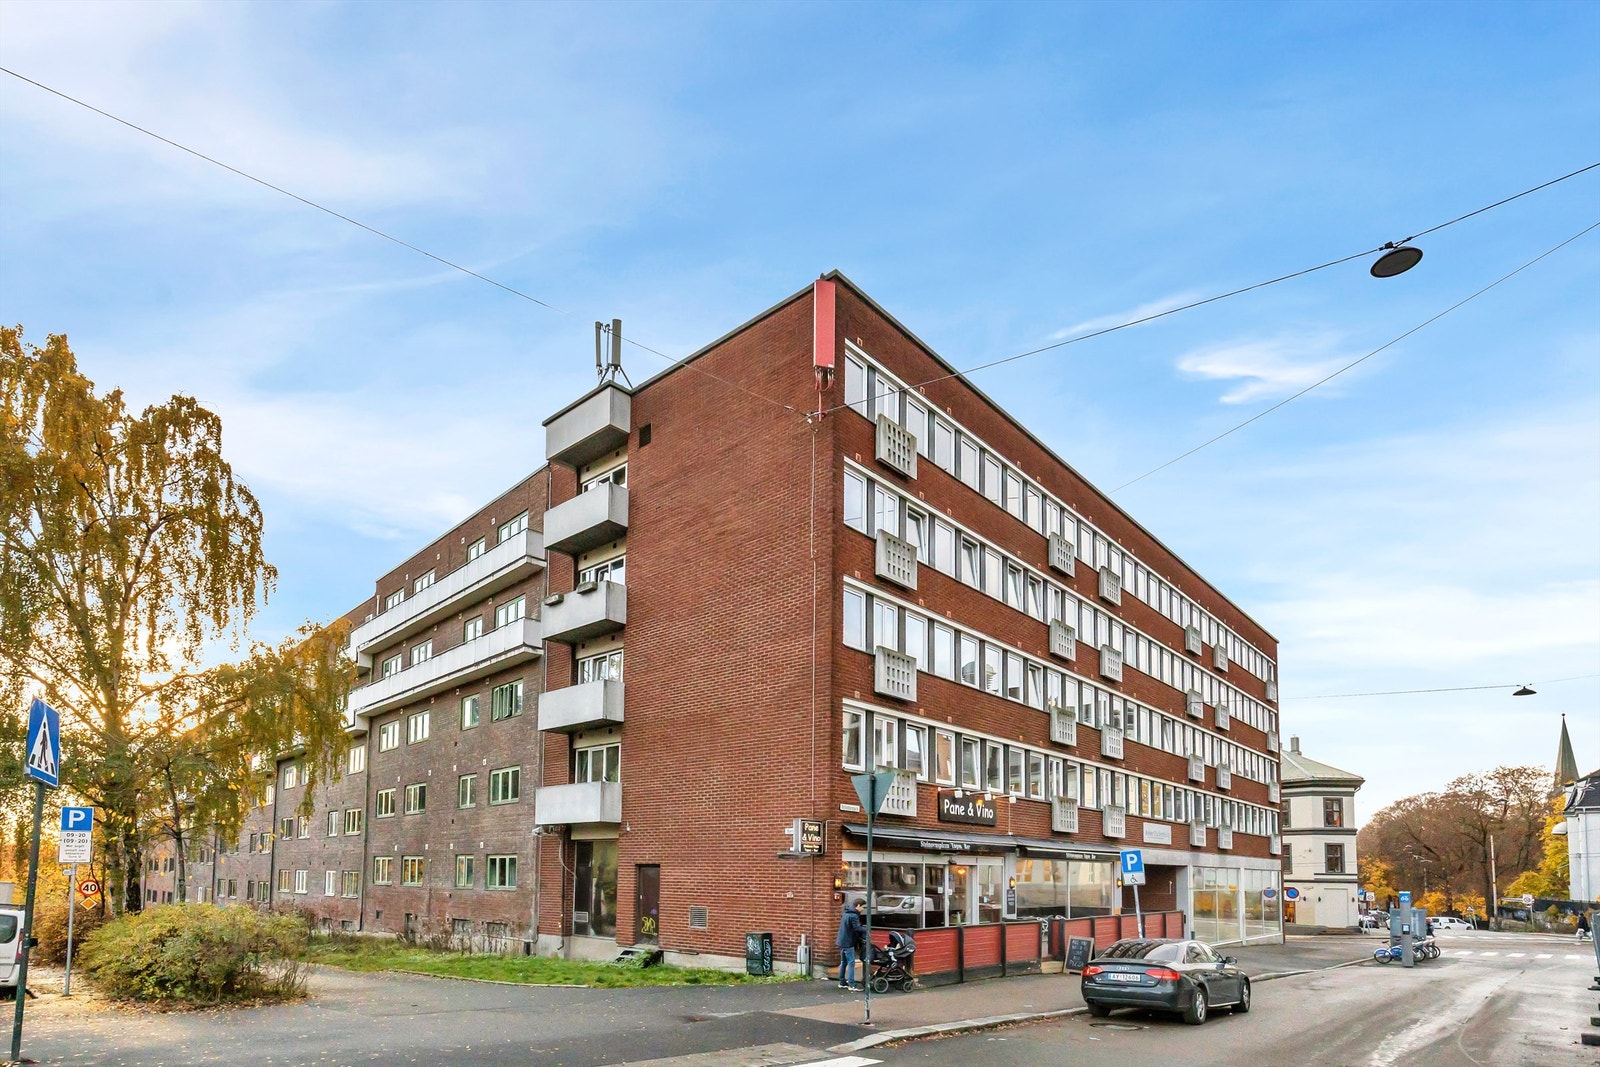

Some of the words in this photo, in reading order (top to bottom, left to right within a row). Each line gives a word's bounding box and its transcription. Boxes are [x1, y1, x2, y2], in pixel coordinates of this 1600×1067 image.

[944, 799, 965, 816] Pane
[967, 802, 974, 817] &
[976, 803, 994, 819] Vino
[68, 809, 86, 829] P
[804, 823, 819, 832] Pane
[802, 833, 807, 841] &
[807, 833, 821, 842] Vino
[1126, 853, 1138, 871] P
[82, 884, 97, 892] 40
